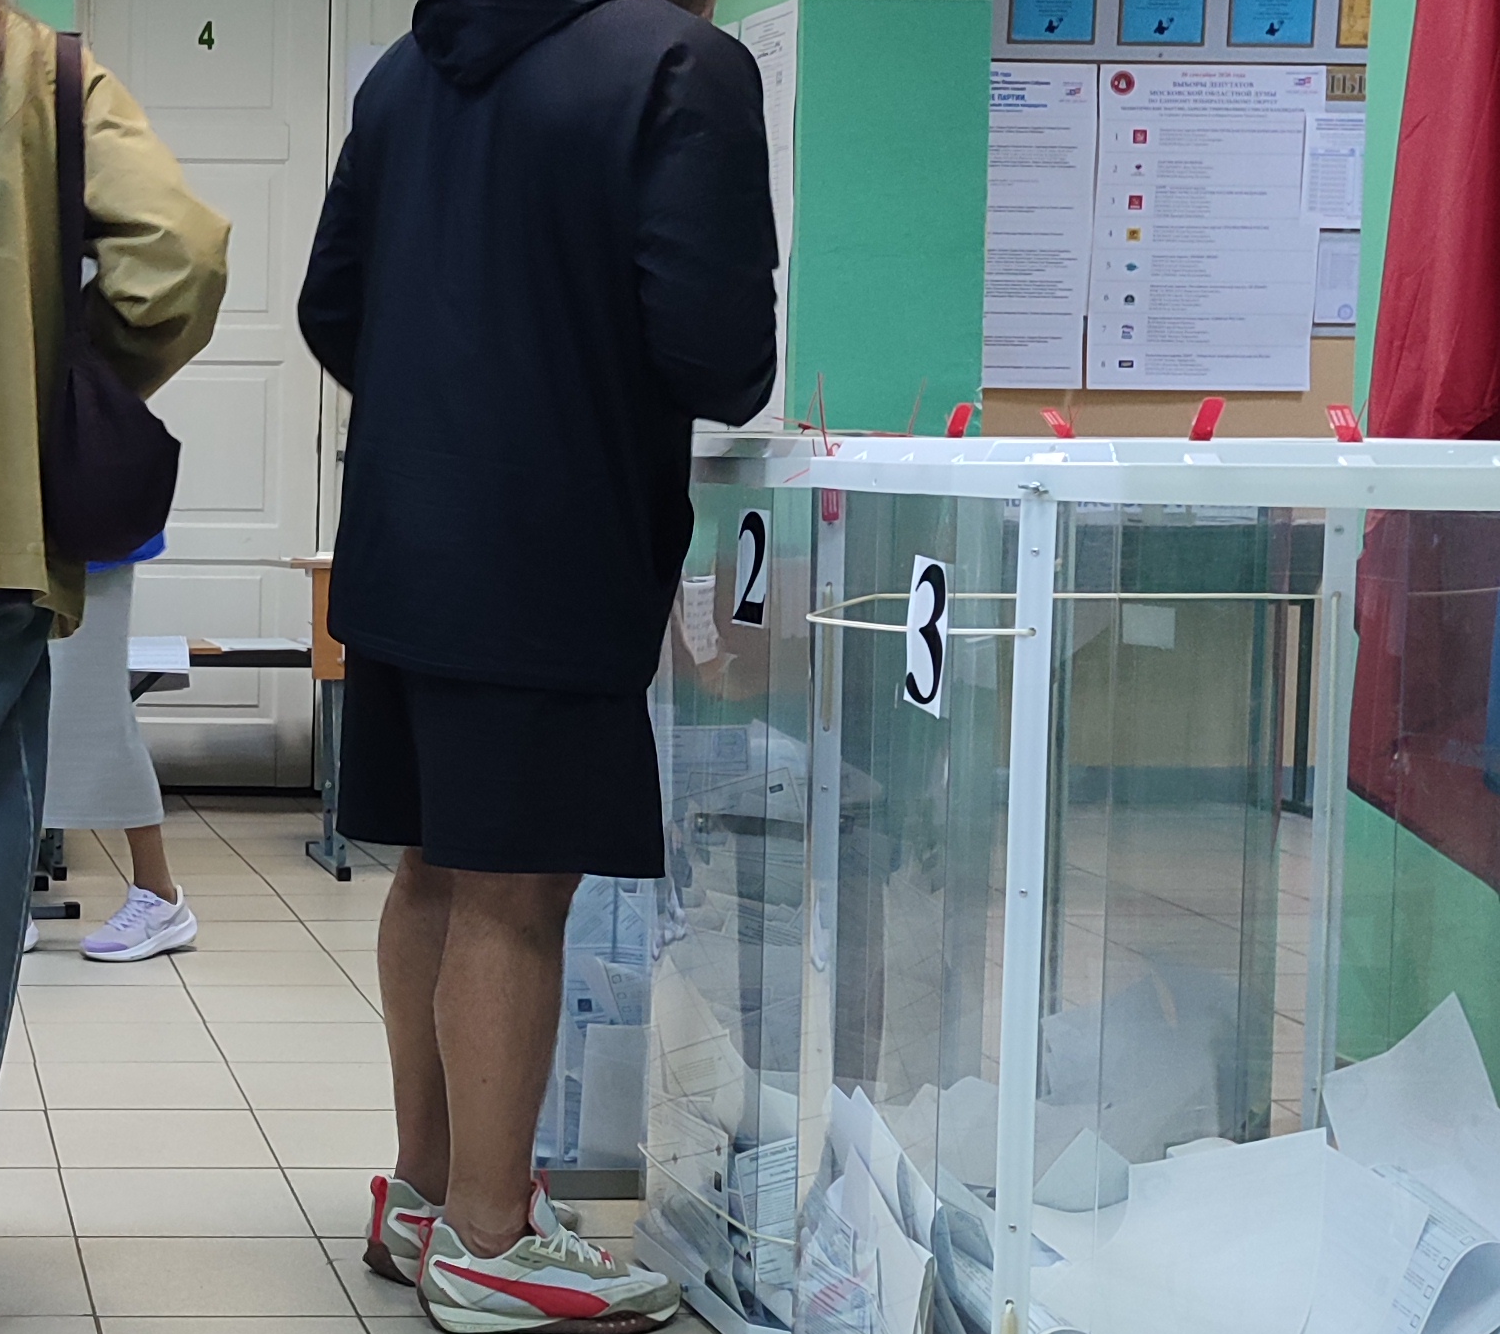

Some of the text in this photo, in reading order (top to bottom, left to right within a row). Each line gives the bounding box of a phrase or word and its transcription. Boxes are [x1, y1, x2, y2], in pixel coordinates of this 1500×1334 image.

[198, 21, 215, 51] 4
[732, 511, 765, 625] 2
[906, 563, 946, 705] 3
